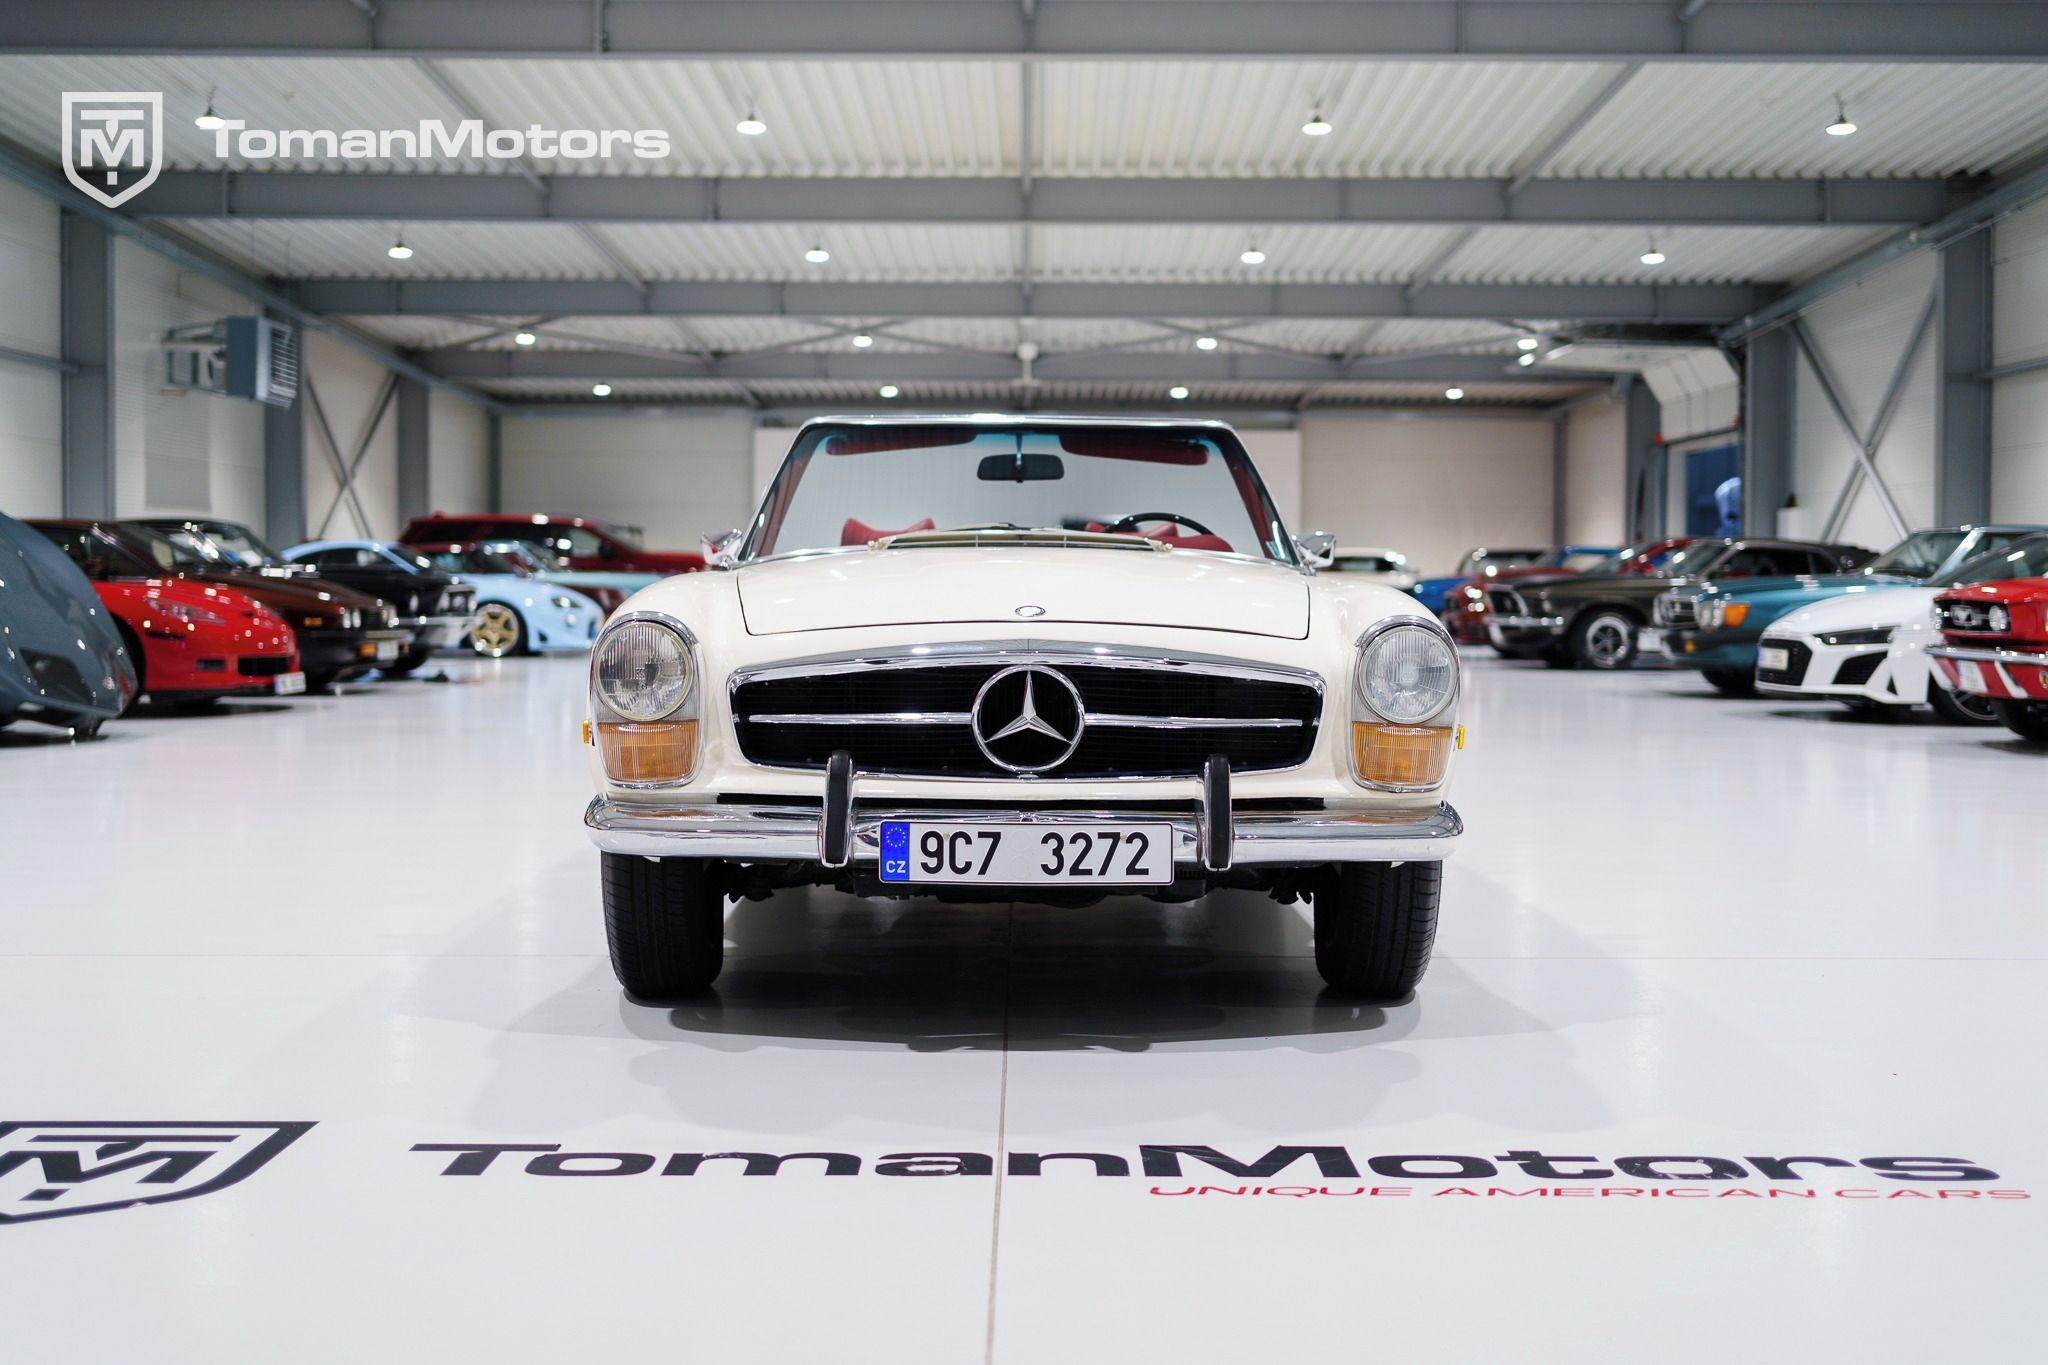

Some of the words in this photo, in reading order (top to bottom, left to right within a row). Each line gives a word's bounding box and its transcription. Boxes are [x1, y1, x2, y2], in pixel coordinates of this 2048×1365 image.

[920, 830, 1002, 876] 9C7
[1040, 831, 1149, 876] 3272
[885, 860, 907, 874] CZ
[409, 1143, 2000, 1182] TomanMotors
[1149, 1185, 1413, 1198] UNIQUE
[1431, 1187, 1816, 1199] AMERICAN
[1834, 1188, 2032, 1200] CARS
